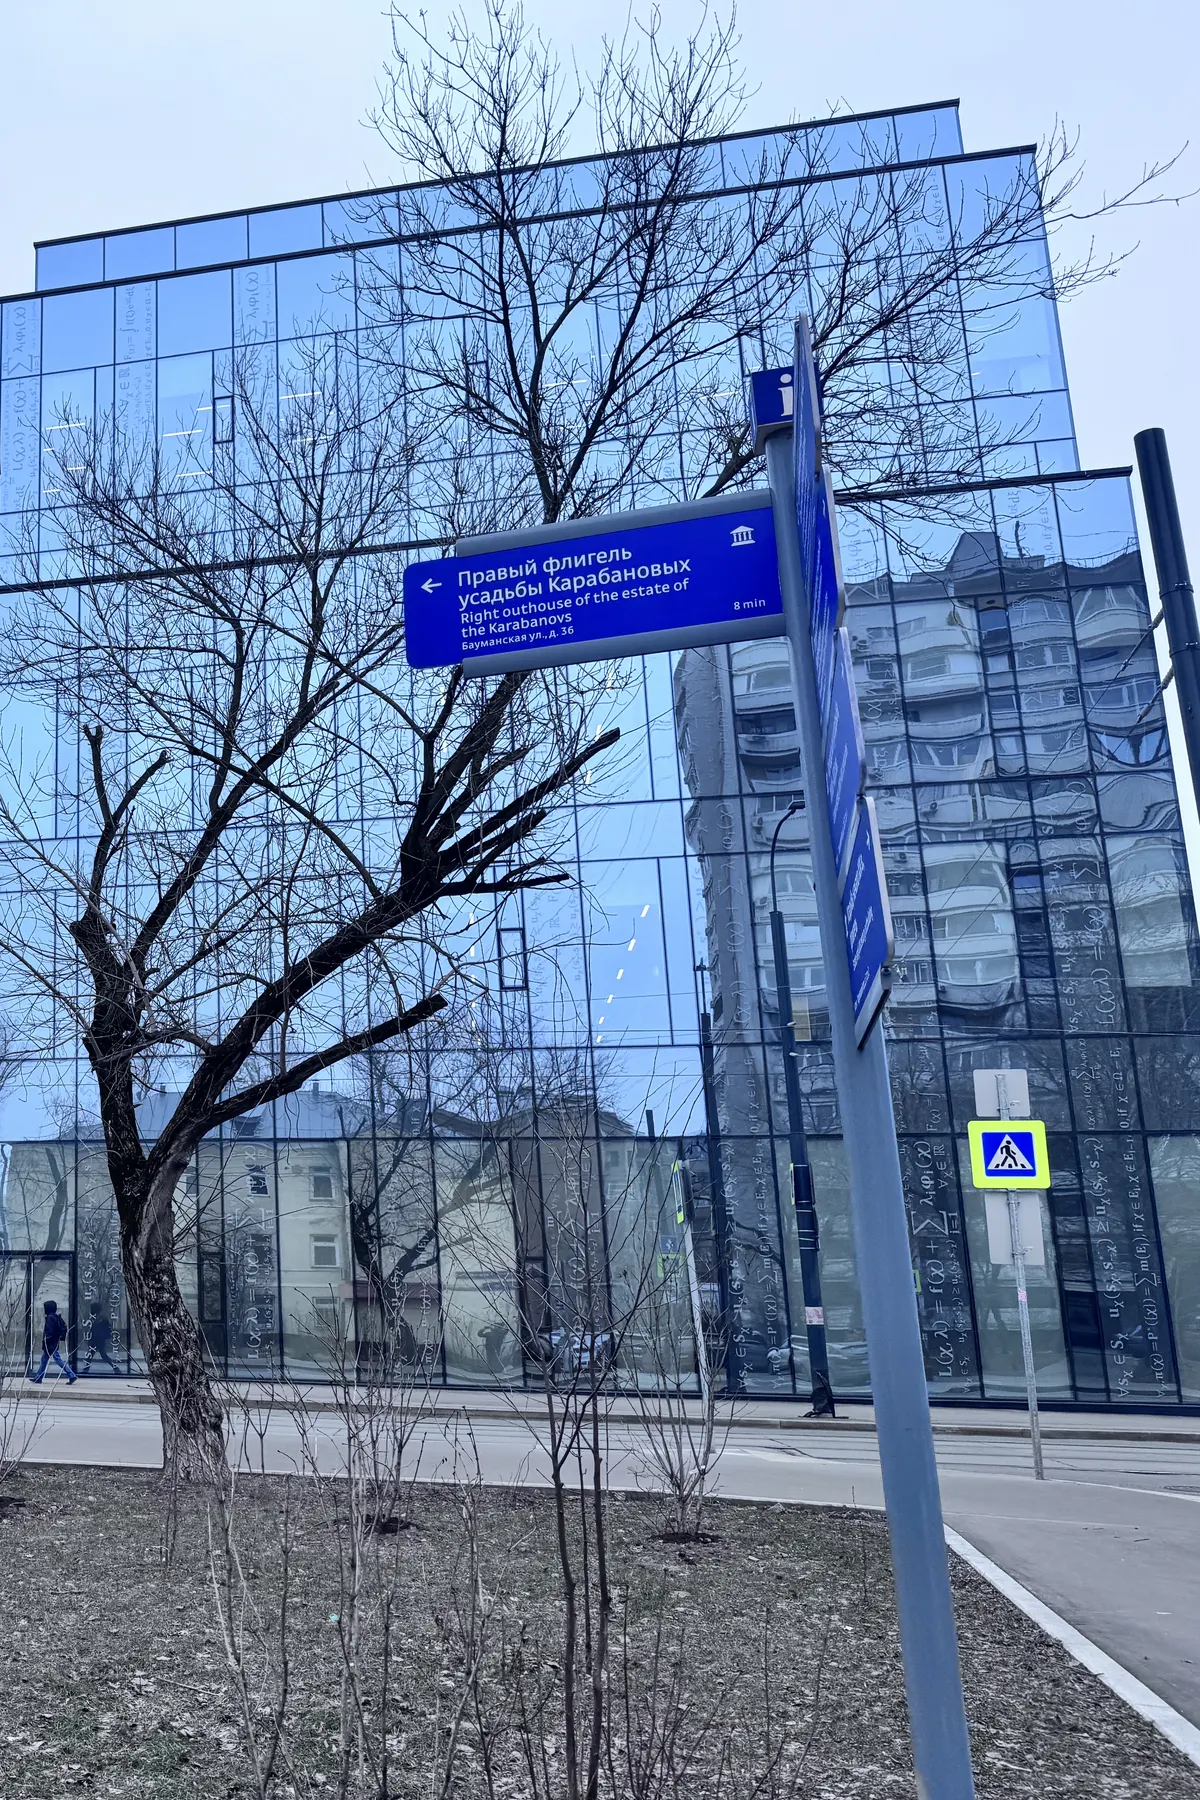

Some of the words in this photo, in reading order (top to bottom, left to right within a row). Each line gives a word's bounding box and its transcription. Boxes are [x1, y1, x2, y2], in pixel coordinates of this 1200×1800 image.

[458, 559, 538, 588] Правый
[543, 547, 632, 576] флигель
[458, 580, 543, 611] усадьбы
[549, 558, 692, 593] Карабановых
[461, 608, 499, 625] Right
[502, 598, 572, 617] outhouse
[575, 593, 590, 606] of
[593, 591, 619, 604] the
[622, 583, 670, 599] estate
[673, 578, 689, 591] of
[733, 601, 741, 610] 8
[743, 598, 766, 609] min
[461, 625, 486, 638] the
[489, 613, 572, 634] Karabanovs
[461, 633, 527, 650] Бауманская
[561, 626, 575, 636] 36
